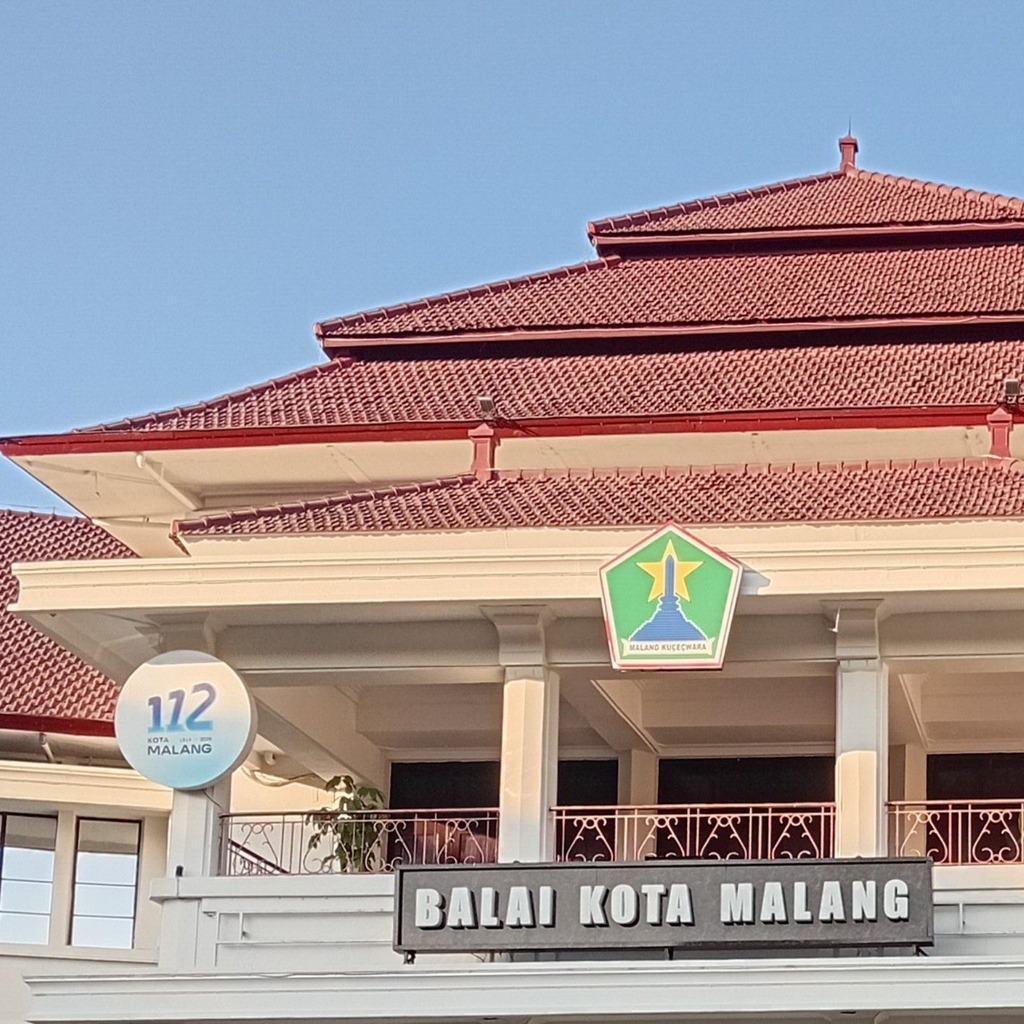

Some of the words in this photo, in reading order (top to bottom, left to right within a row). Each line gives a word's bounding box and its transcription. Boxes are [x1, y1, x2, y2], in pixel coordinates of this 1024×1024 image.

[147, 682, 217, 733] 112
[147, 744, 212, 755] MALANG
[415, 886, 556, 930] BALAI
[580, 883, 695, 926] KOTA
[720, 879, 911, 924] MALANG
